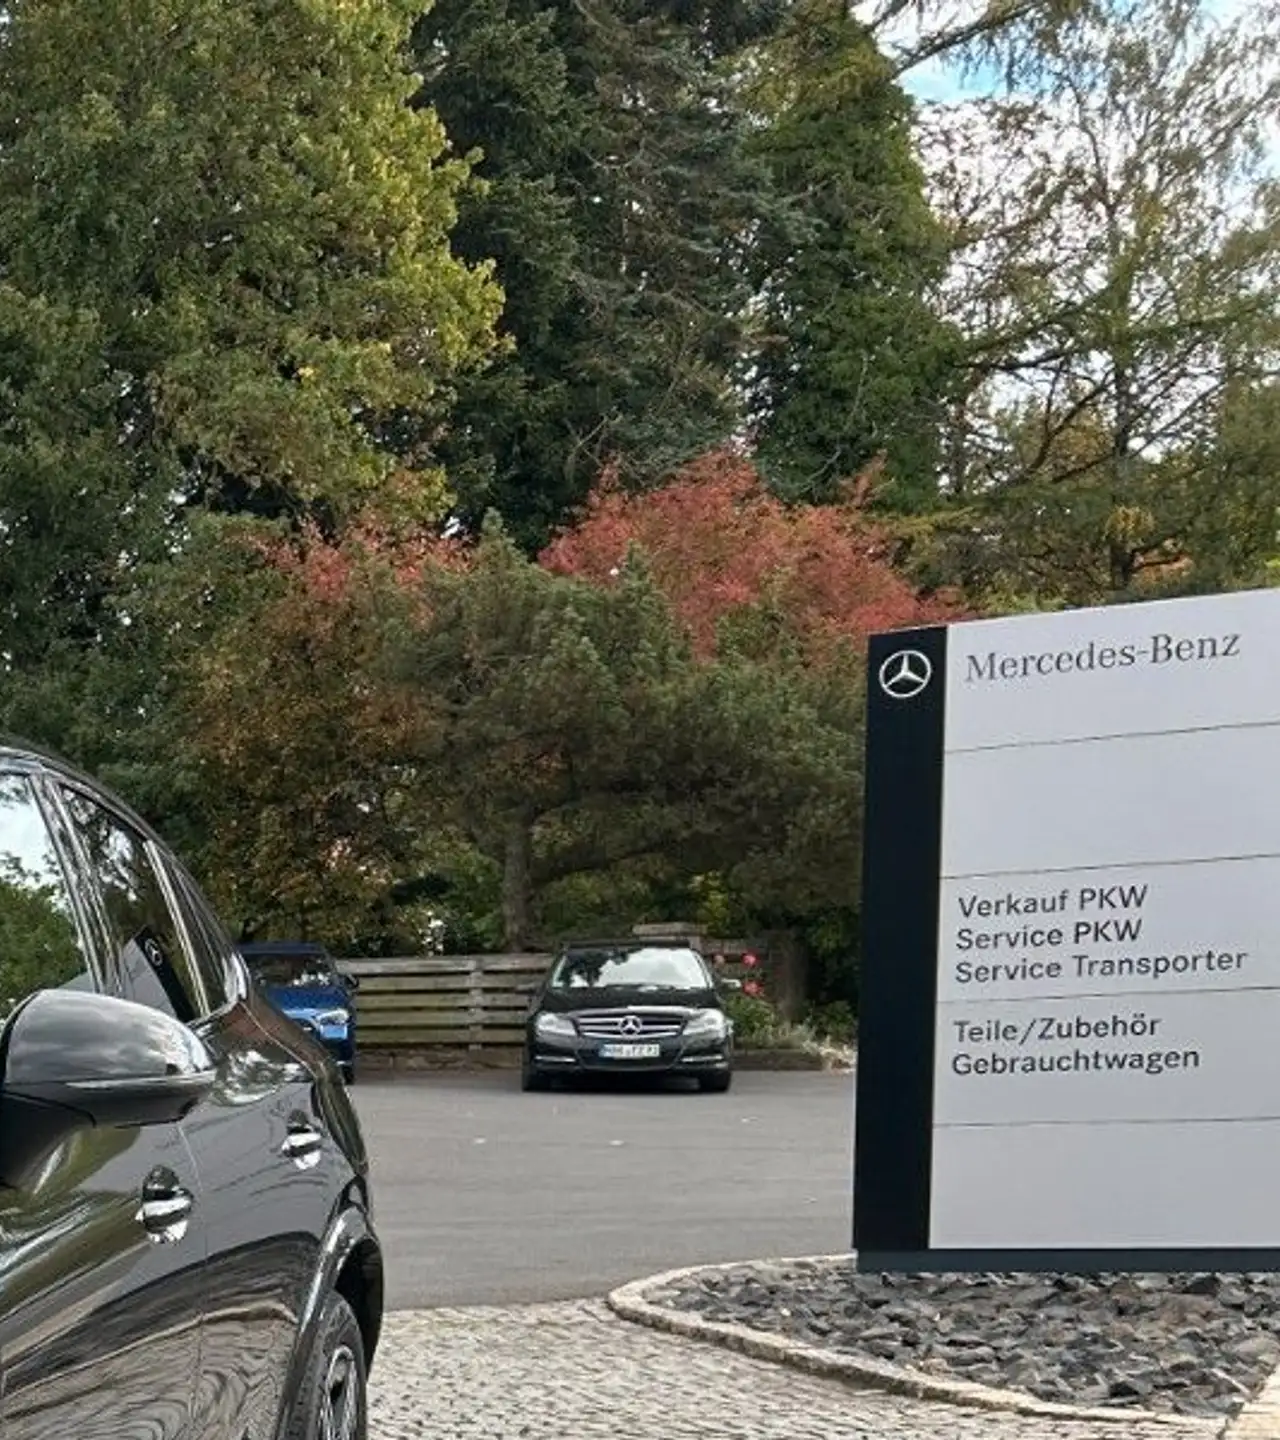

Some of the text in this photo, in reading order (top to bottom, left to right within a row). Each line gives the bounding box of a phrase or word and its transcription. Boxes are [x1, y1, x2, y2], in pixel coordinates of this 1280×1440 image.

[965, 633, 1242, 683] Mercedes-Benz
[958, 884, 1148, 918] Verkauf PKW
[955, 918, 1143, 950] Service PKW
[955, 950, 1249, 983] Service Transporter
[952, 1013, 1162, 1046] Teile/Zubehör
[951, 1050, 1201, 1076] Gebrauchtwagen
